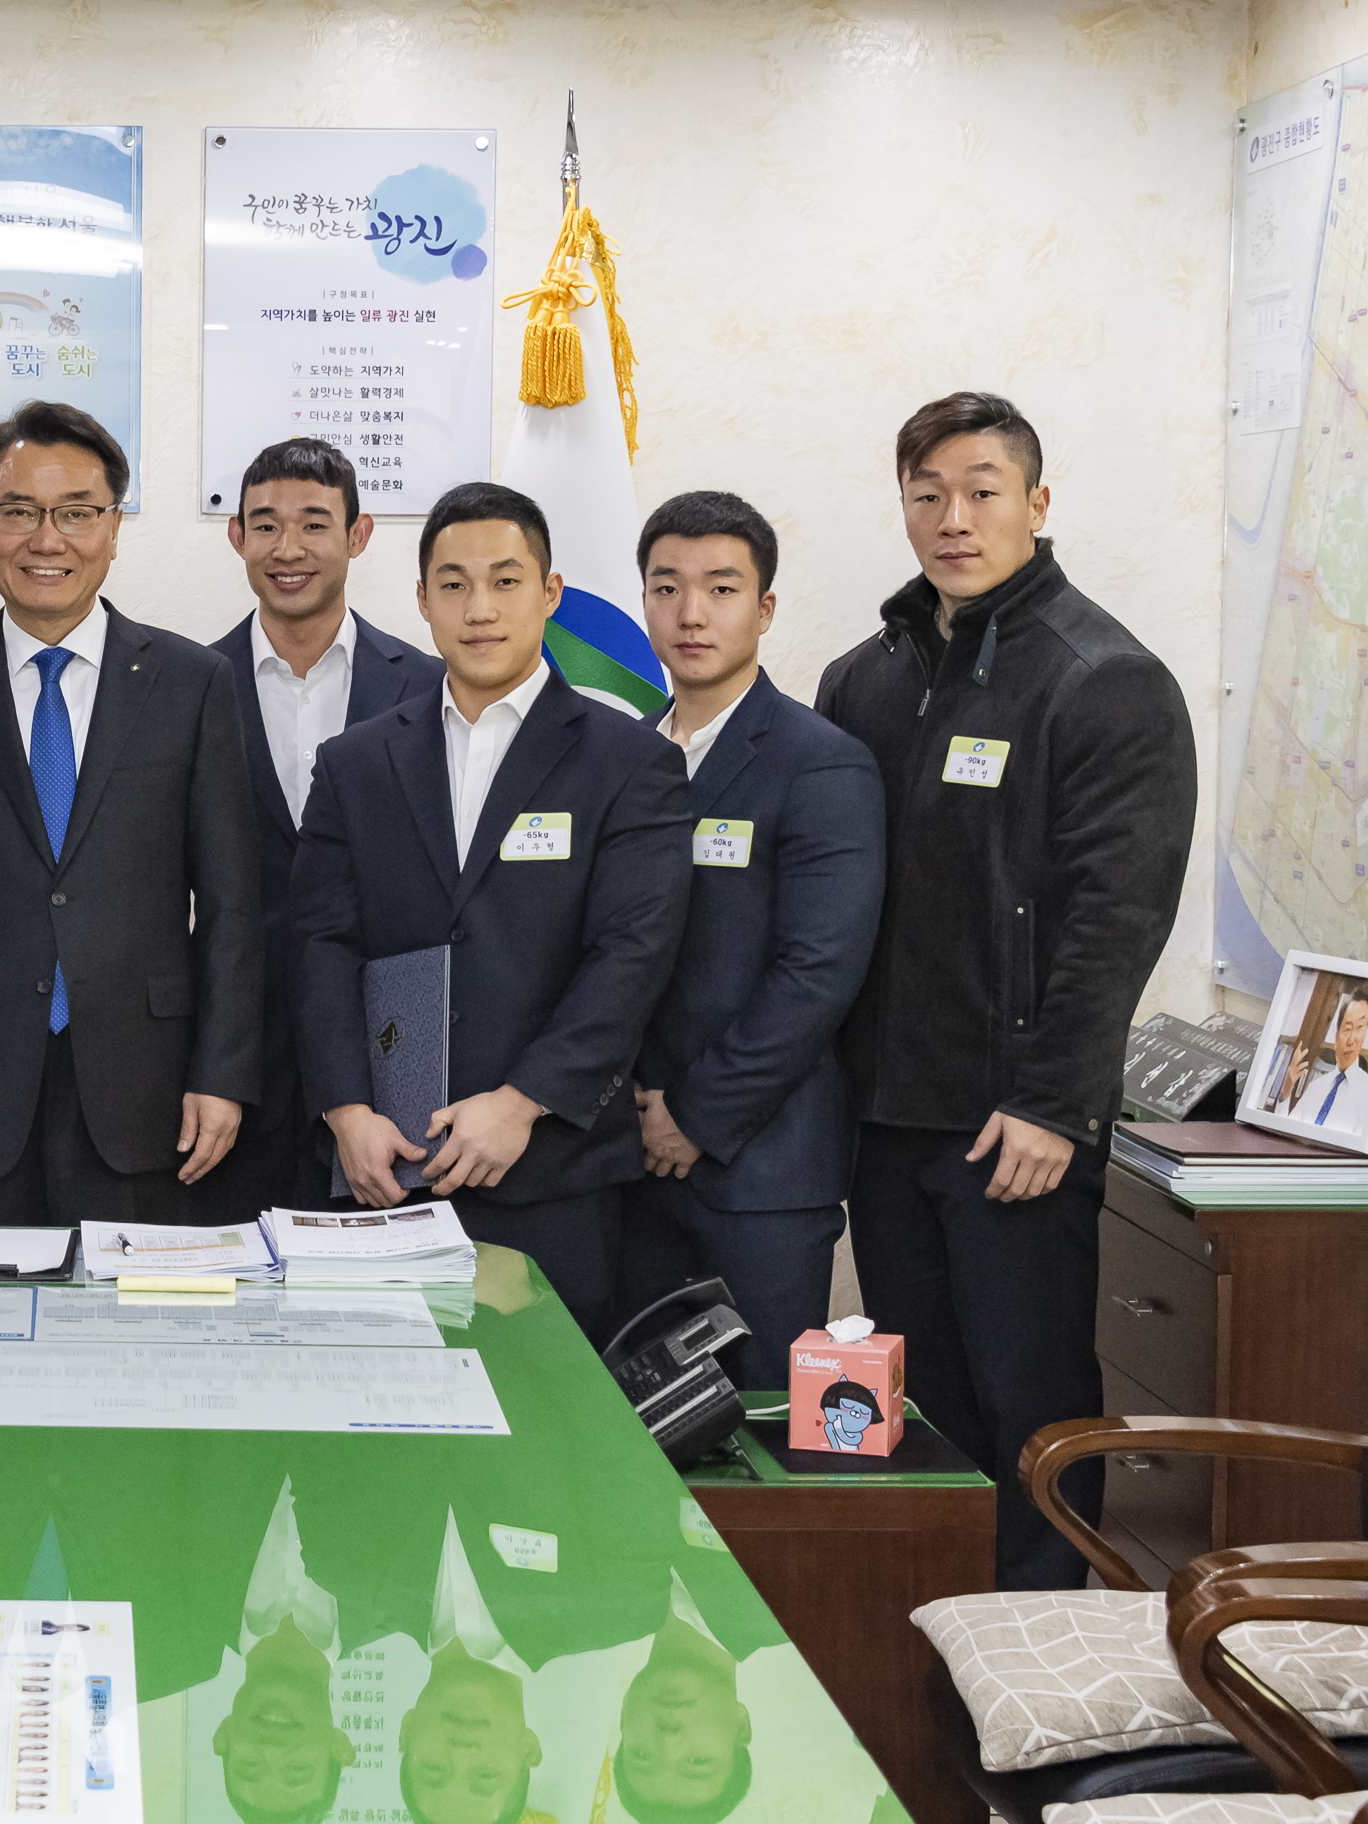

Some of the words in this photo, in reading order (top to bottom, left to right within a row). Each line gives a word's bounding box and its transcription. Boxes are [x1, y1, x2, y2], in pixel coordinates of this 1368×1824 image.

[242, 193, 289, 225] 구민이
[293, 192, 343, 218] 꿈꾸는
[345, 195, 378, 212] 가치
[309, 219, 362, 241] 만드는
[363, 211, 458, 256] 광진
[260, 309, 318, 322] 지역가치를
[322, 309, 356, 323] 높이는
[360, 310, 383, 323] 일류
[386, 309, 410, 323] 광진
[413, 309, 436, 323] 실현
[5, 345, 47, 361] 꿈꾸는
[56, 346, 98, 362] 숨쉬는
[11, 363, 40, 377] 도시
[61, 363, 91, 377] 도시
[309, 365, 354, 376] 도약하는
[360, 365, 405, 377] 지역가치
[309, 387, 354, 399] 살맛나는
[360, 387, 405, 399] 활력경제
[309, 411, 353, 423] 더나은삶
[360, 411, 405, 423] 맞춤복지
[359, 433, 404, 446] 생활안전
[358, 456, 403, 469] 혁신교육
[358, 479, 404, 491] 예술문화
[796, 1353, 842, 1371] Kleenex
